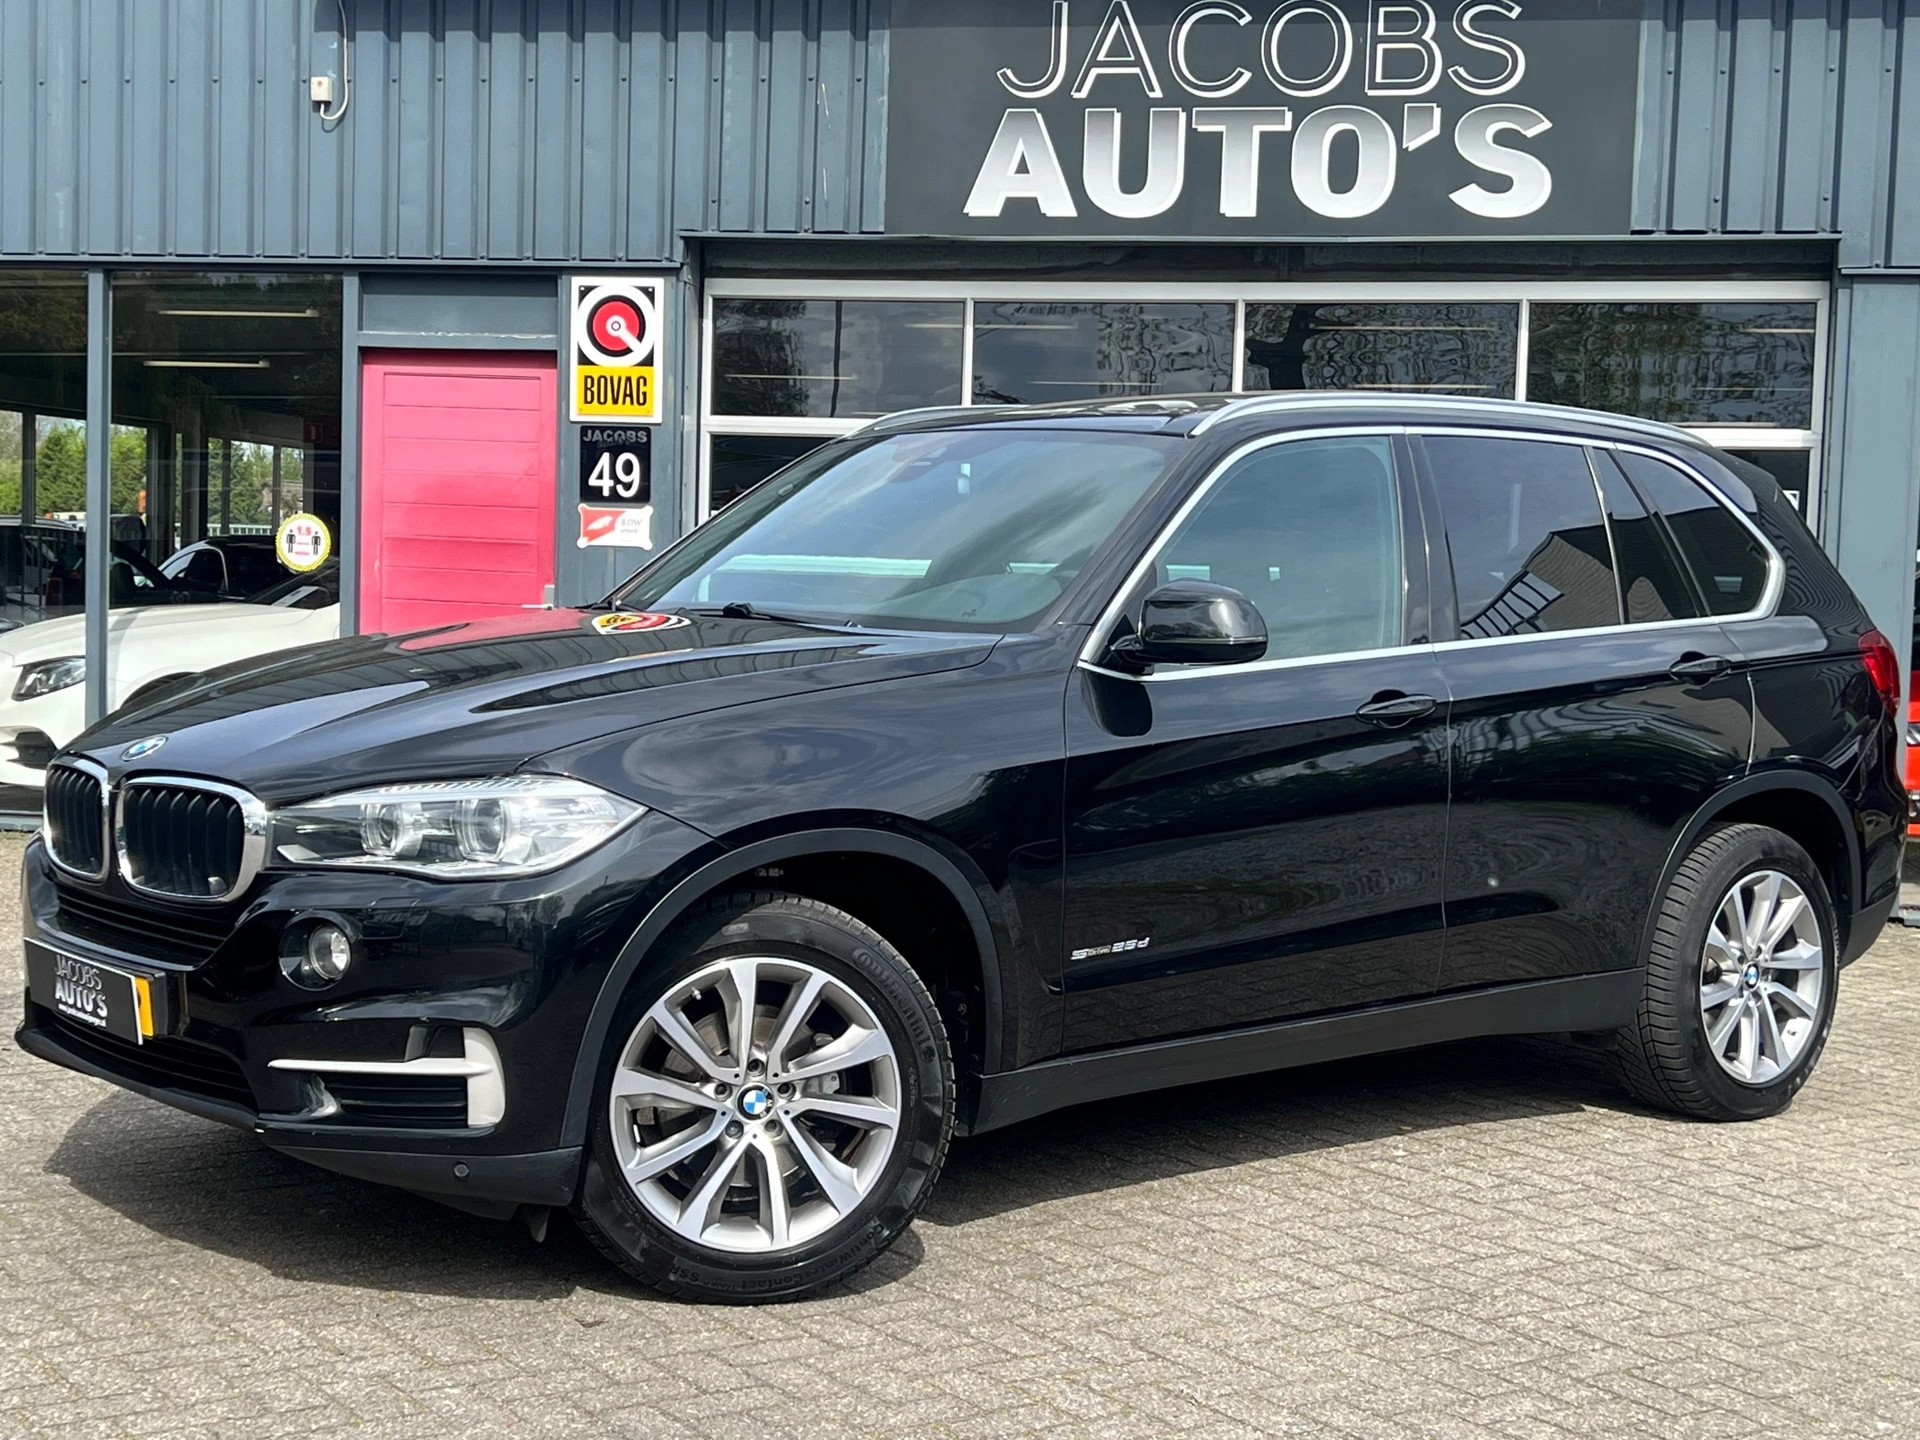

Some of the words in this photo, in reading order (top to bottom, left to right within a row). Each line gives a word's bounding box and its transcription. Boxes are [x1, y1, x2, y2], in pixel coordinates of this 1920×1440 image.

[996, 0, 1526, 98] JACOBS
[963, 103, 1553, 219] AUTO'S
[583, 374, 648, 407] BOVAG
[583, 430, 648, 443] JACOBS
[588, 451, 640, 498] 49
[55, 954, 102, 990] JACOBS
[55, 978, 108, 1017] AUTO'S
